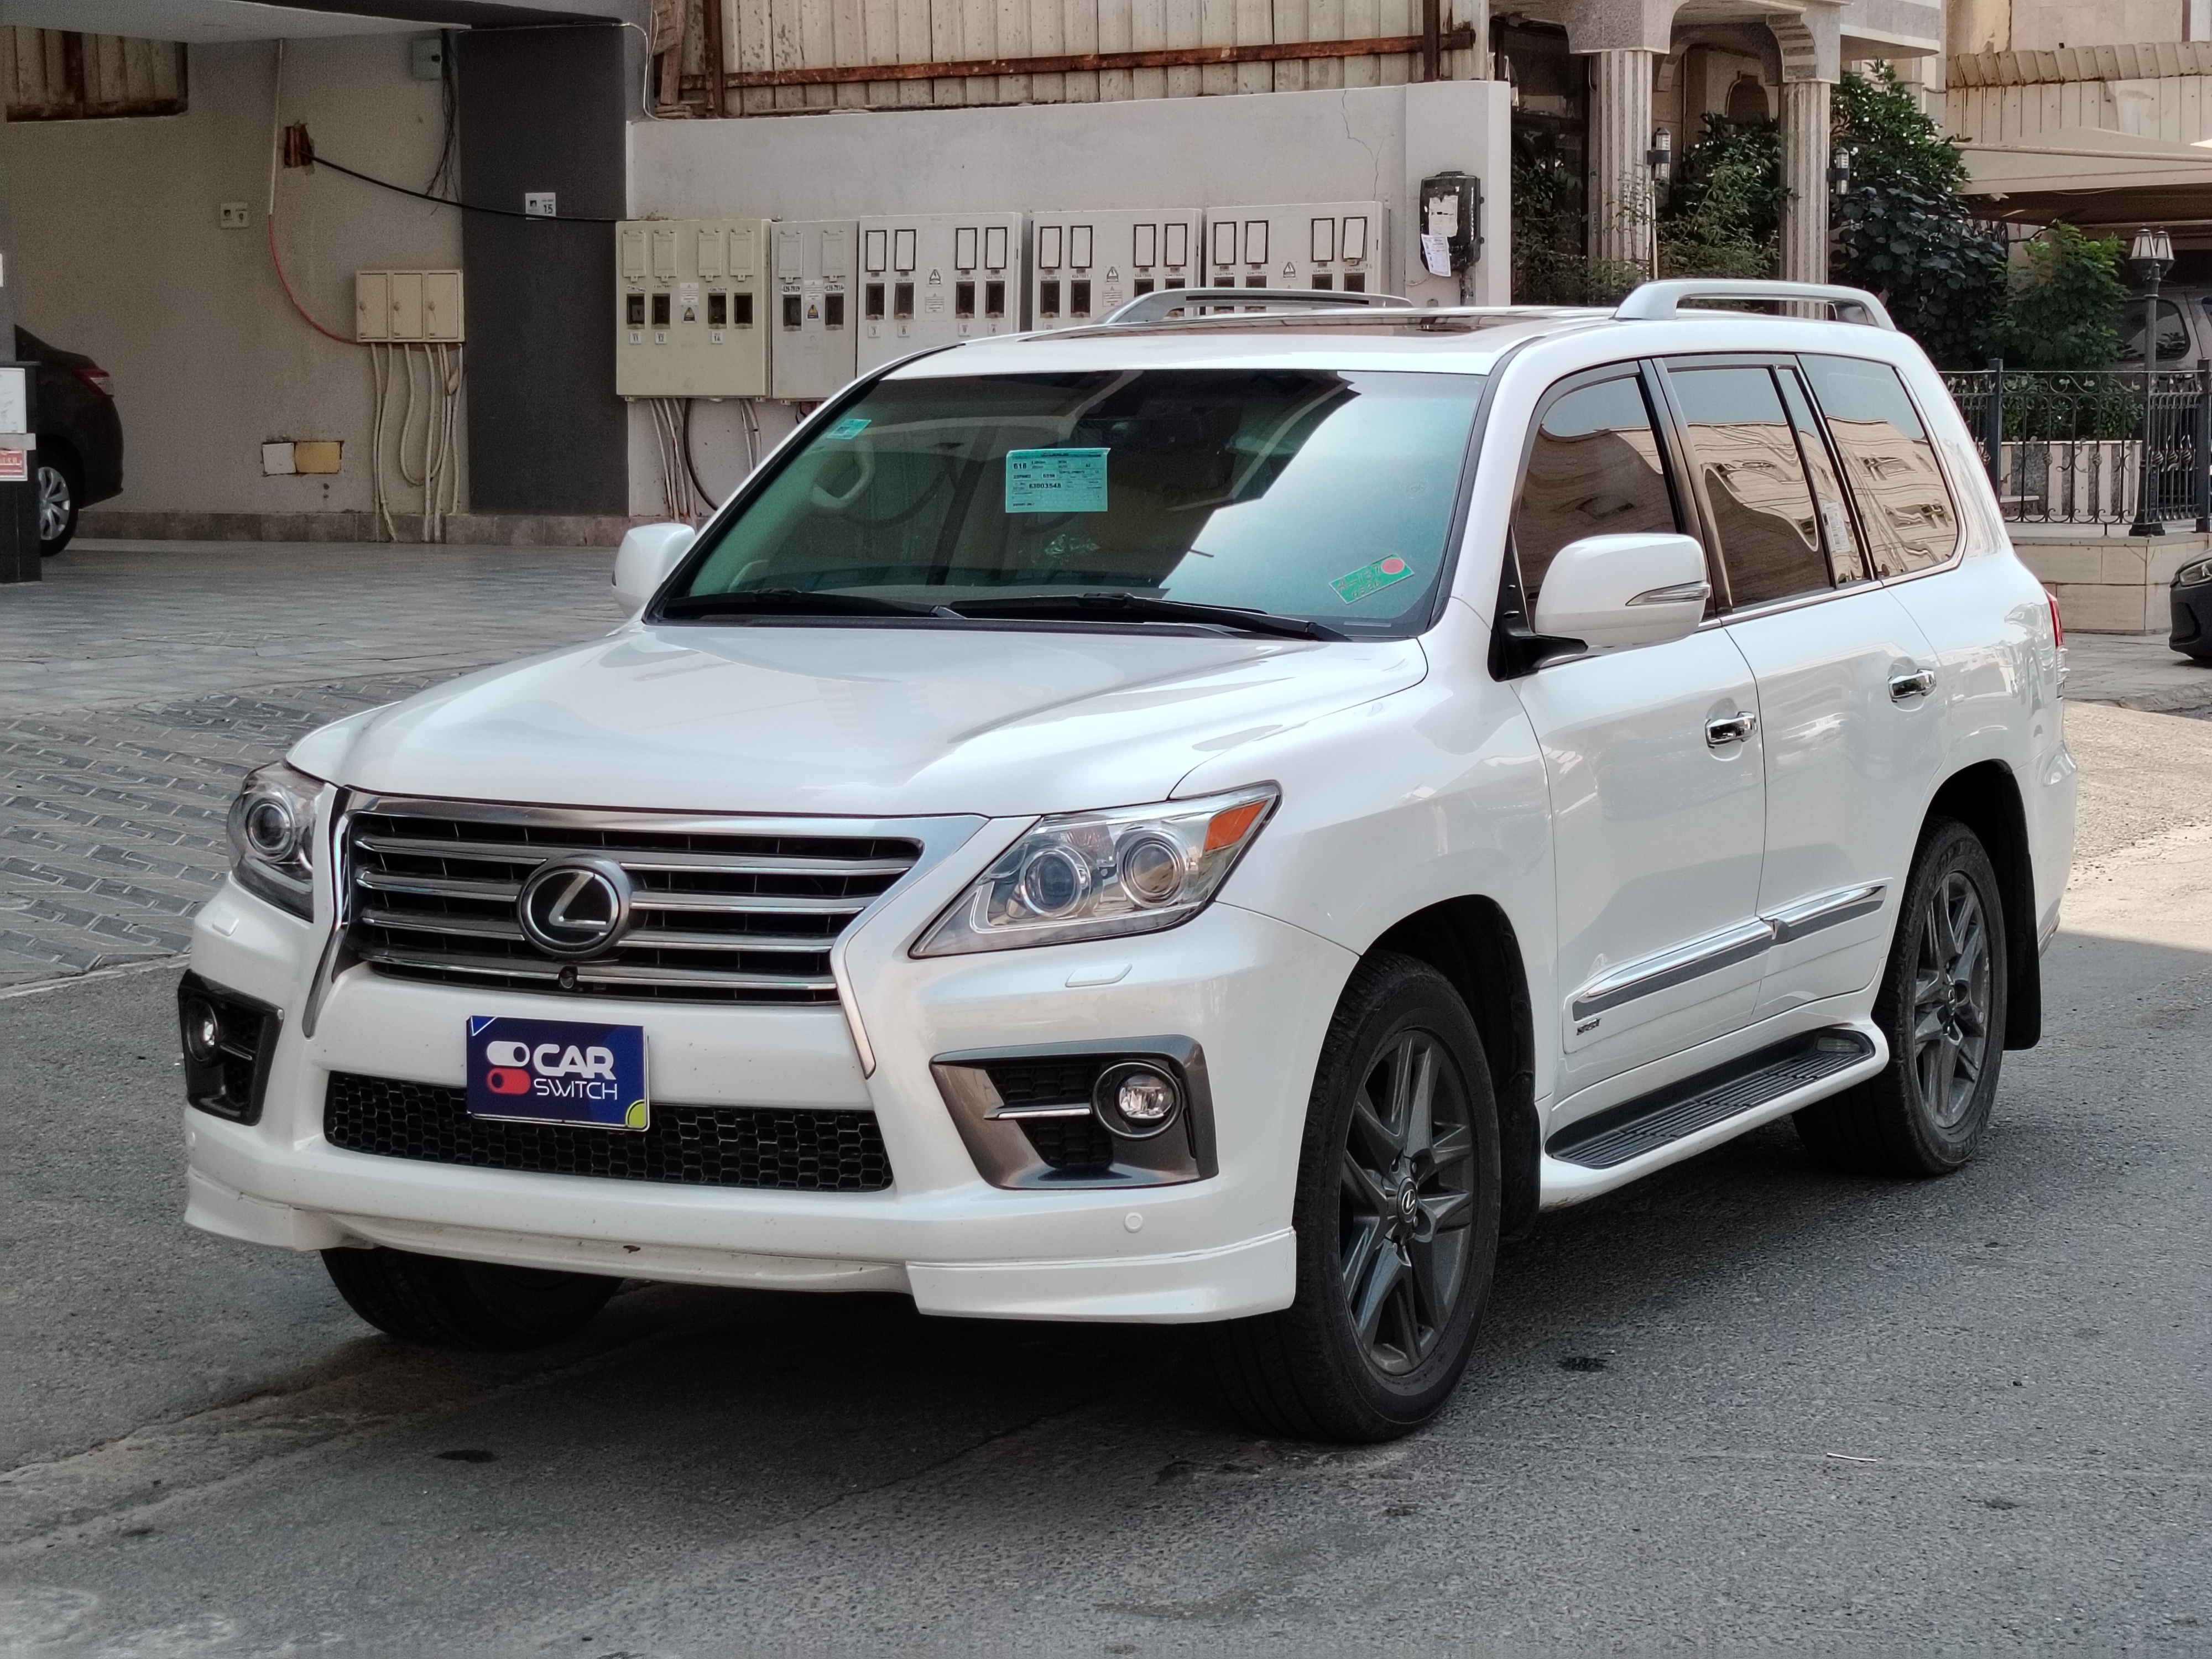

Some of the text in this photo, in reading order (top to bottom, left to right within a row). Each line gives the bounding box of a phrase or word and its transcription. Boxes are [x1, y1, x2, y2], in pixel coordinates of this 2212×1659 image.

[544, 204, 553, 214] 15
[533, 1044, 617, 1080] CAR
[534, 1078, 618, 1100] SWITCH
